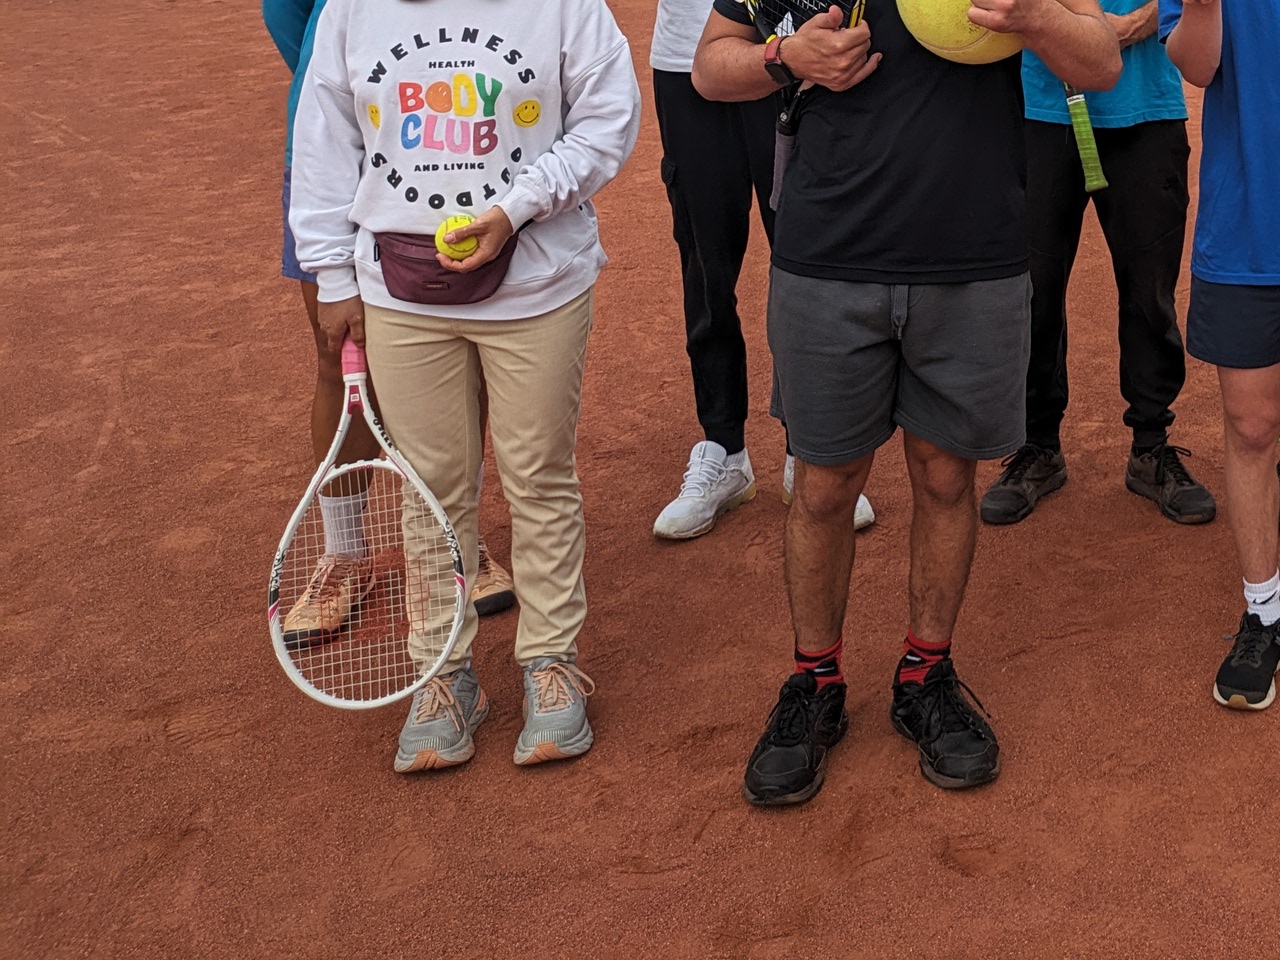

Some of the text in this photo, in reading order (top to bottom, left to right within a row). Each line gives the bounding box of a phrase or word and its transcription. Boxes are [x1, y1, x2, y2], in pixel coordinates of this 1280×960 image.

[366, 27, 536, 85] WELLNESS
[428, 60, 476, 69] HEALTH
[398, 72, 503, 117] BODY
[400, 113, 499, 157] CLUB
[414, 162, 485, 172] AND LIVING
